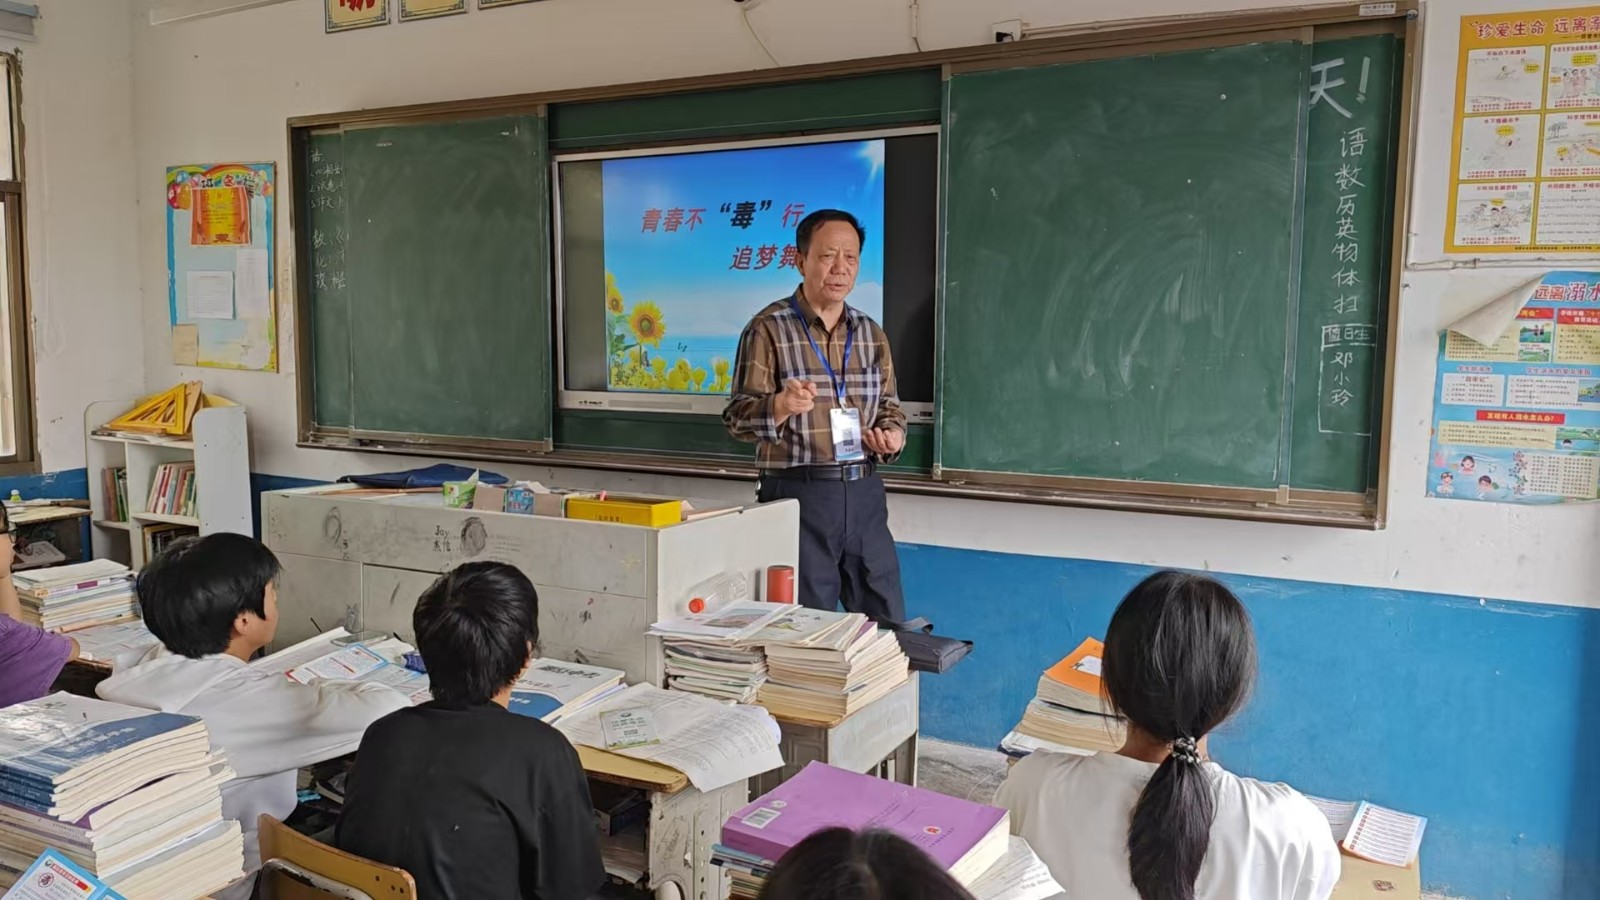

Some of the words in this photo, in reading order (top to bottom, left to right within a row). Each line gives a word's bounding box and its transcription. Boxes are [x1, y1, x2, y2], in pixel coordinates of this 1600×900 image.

[1478, 20, 1545, 38] 珍爱生命
[1326, 326, 1371, 341] 值日生
[1330, 351, 1354, 406] 邓小玲
